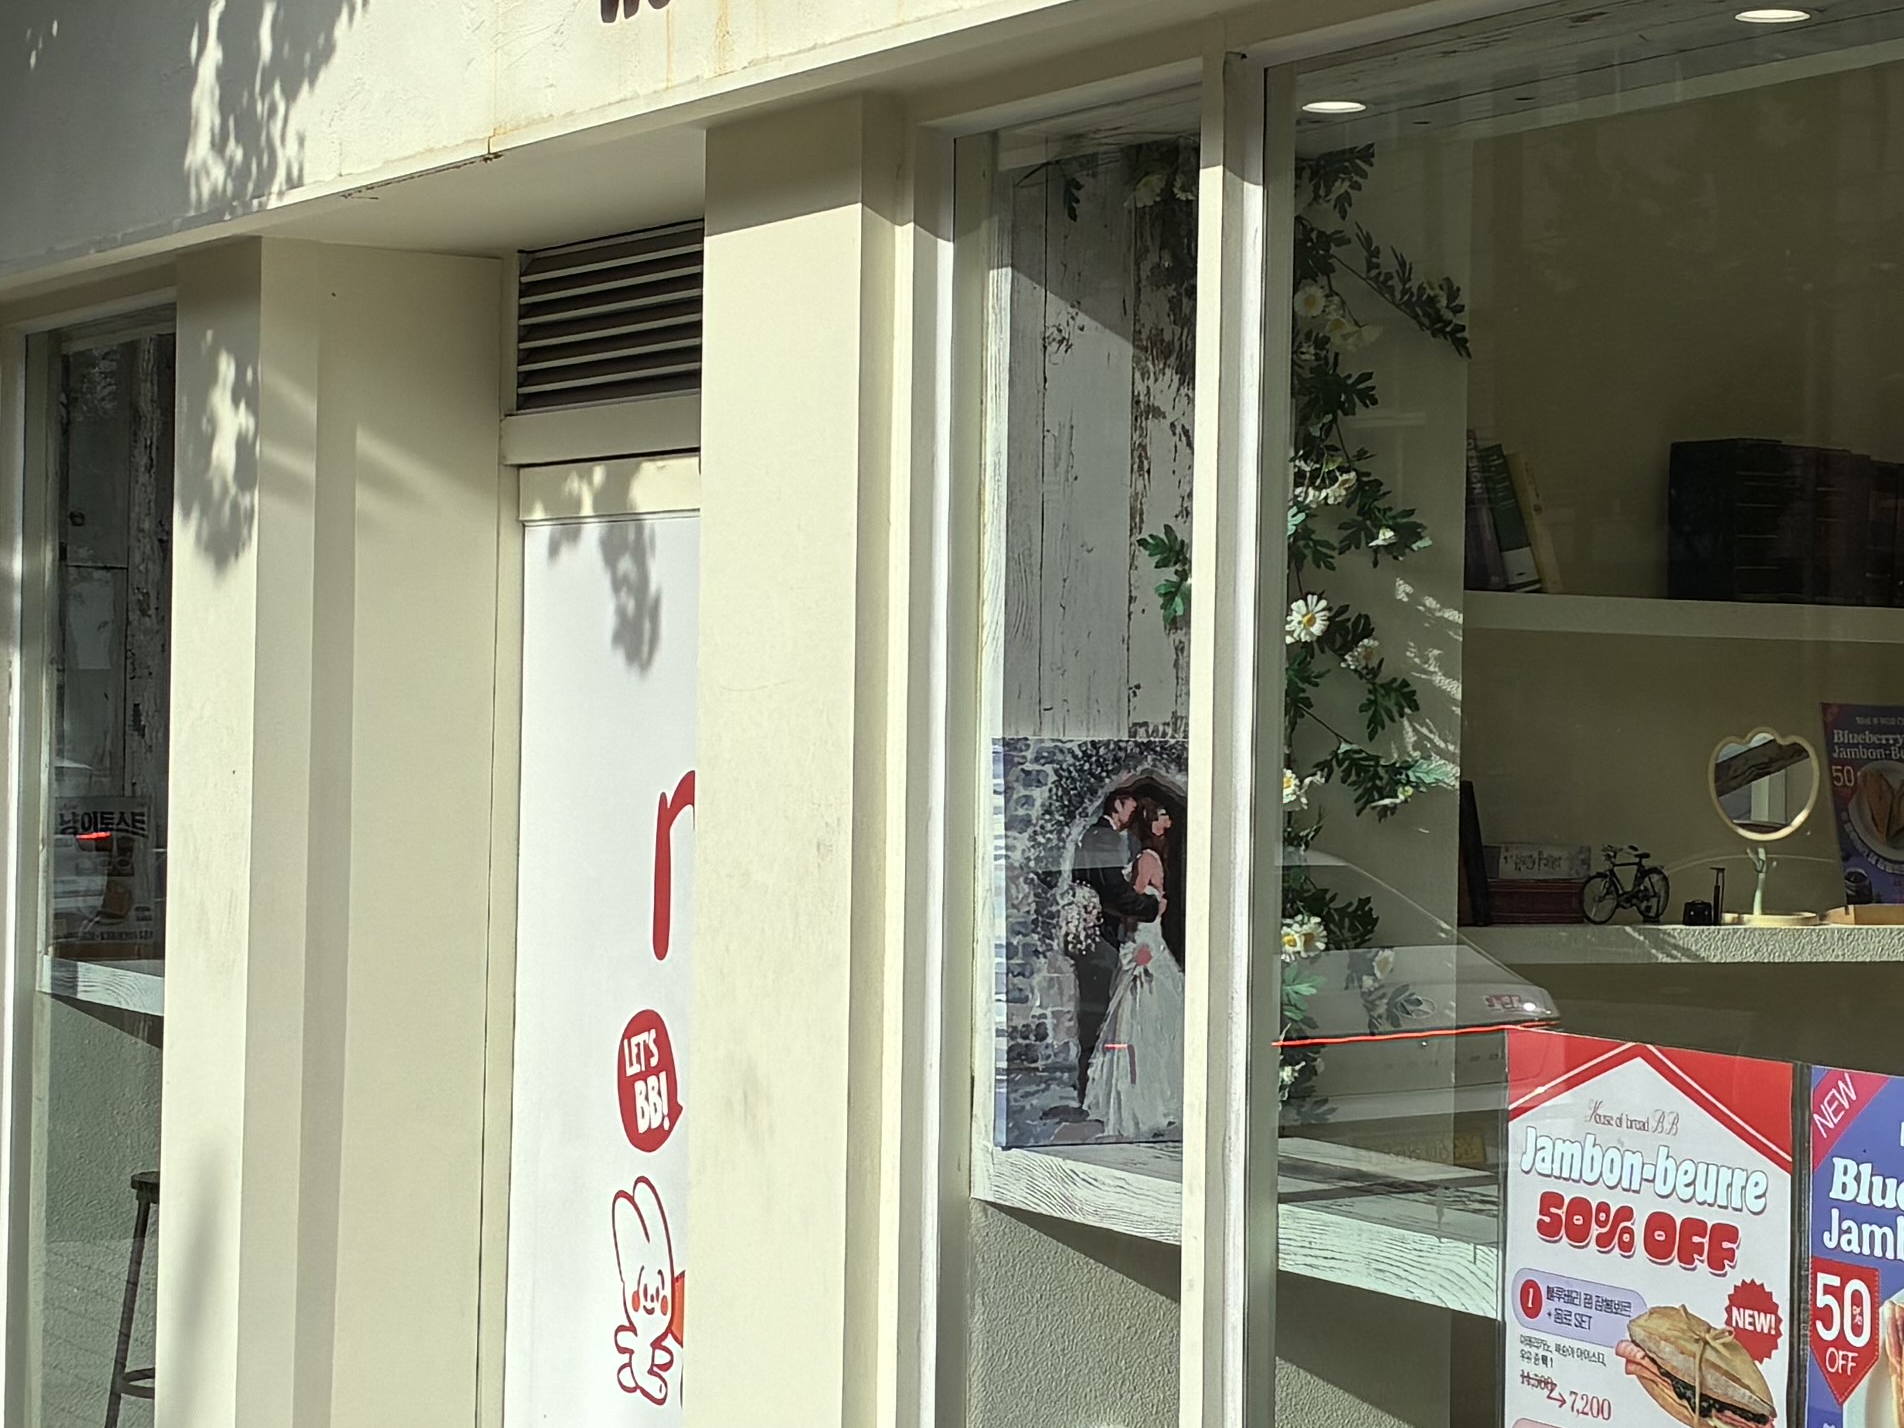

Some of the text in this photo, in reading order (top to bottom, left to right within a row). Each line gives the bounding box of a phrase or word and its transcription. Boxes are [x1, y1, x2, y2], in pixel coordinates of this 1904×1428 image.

[622, 1028, 659, 1077] LET'S
[633, 1070, 671, 1134] BB!
[1812, 1071, 1858, 1139] NEW
[1520, 1125, 1770, 1216] Jambon-beurre
[1536, 1190, 1742, 1278] 50% OFF
[1546, 1285, 1582, 1307] 블루베리
[1573, 1312, 1593, 1331] SET
[1730, 1308, 1777, 1335] NEW!
[1825, 1348, 1859, 1376] OFF
[1569, 1390, 1612, 1421] 7,200
